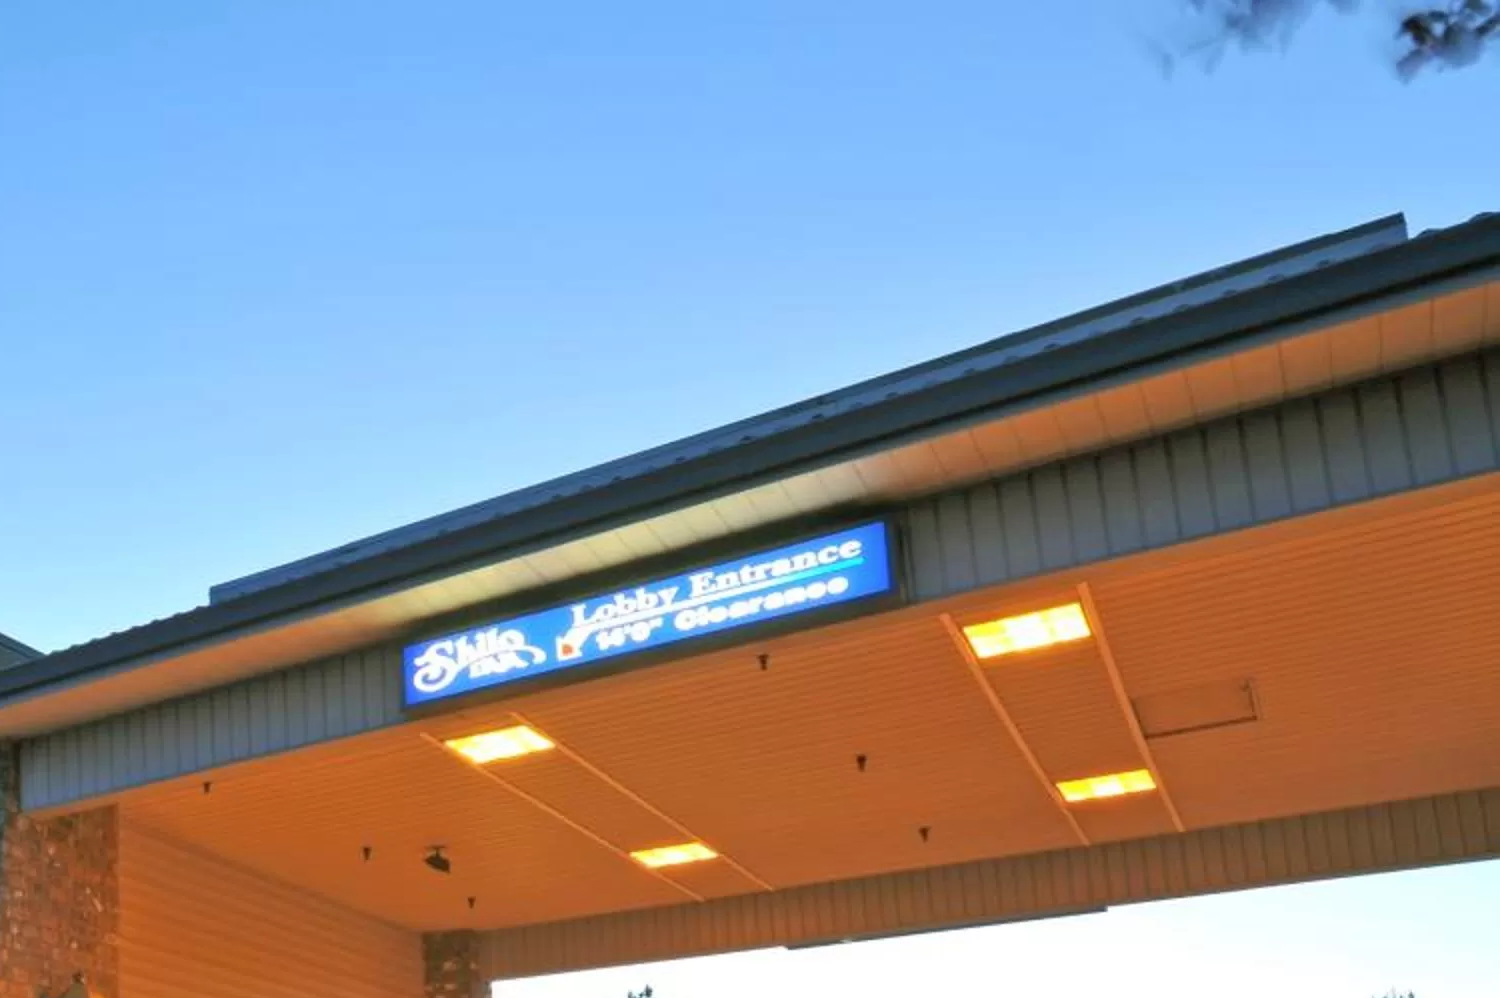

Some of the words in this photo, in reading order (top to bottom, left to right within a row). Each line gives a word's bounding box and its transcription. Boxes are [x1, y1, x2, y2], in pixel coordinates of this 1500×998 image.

[571, 585, 679, 628] Lobby
[688, 538, 863, 598] Entrance
[673, 575, 849, 631] Clearance
[412, 626, 548, 693] Shilo
